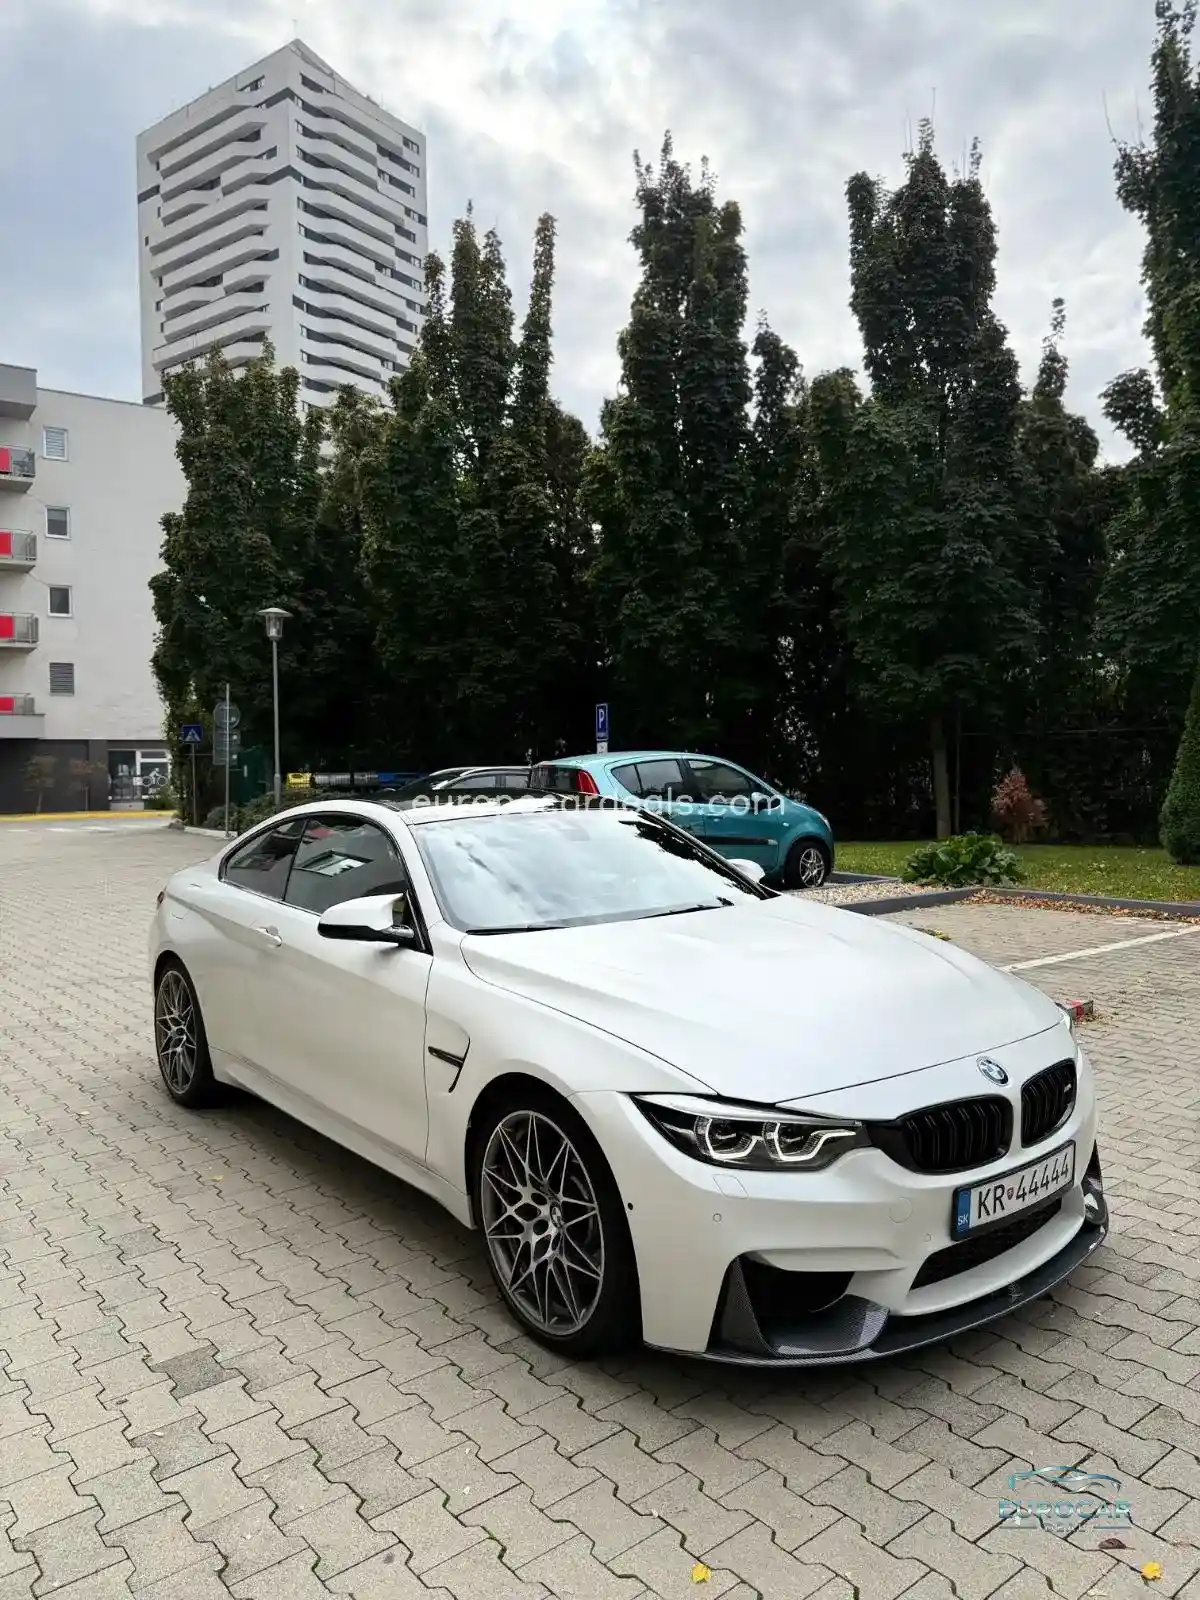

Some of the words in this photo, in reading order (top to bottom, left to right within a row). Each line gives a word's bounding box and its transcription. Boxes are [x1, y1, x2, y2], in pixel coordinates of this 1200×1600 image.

[598, 708, 605, 729] P
[977, 1184, 1006, 1220] KR
[1015, 1153, 1070, 1202] 44444
[957, 1213, 969, 1226] SK
